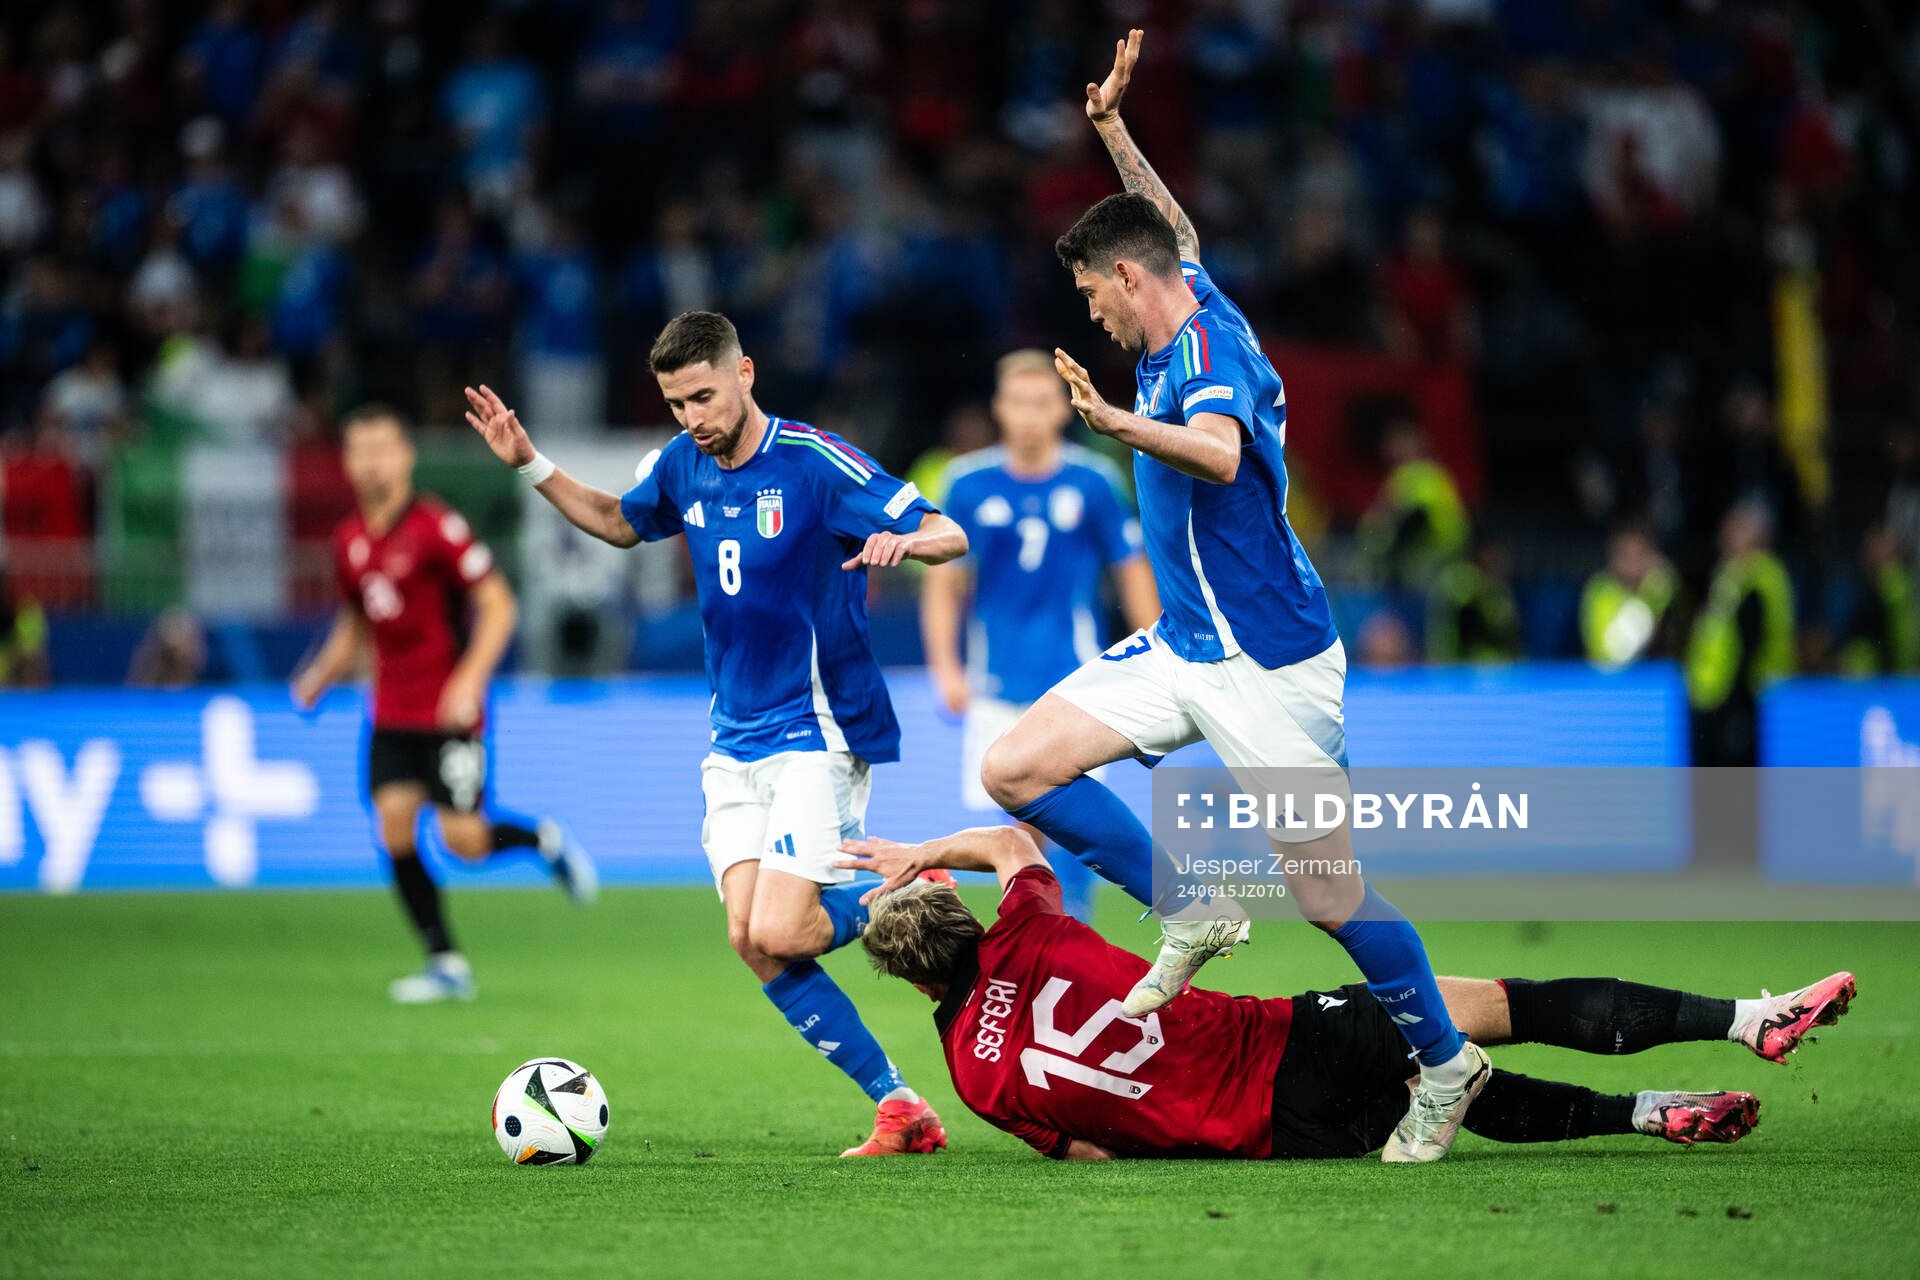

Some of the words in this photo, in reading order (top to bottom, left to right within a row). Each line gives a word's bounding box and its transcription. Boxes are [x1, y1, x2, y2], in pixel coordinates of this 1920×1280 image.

[718, 539, 741, 596] 8
[973, 978, 1018, 1063] SEFERI
[1019, 976, 1165, 1100] 15
